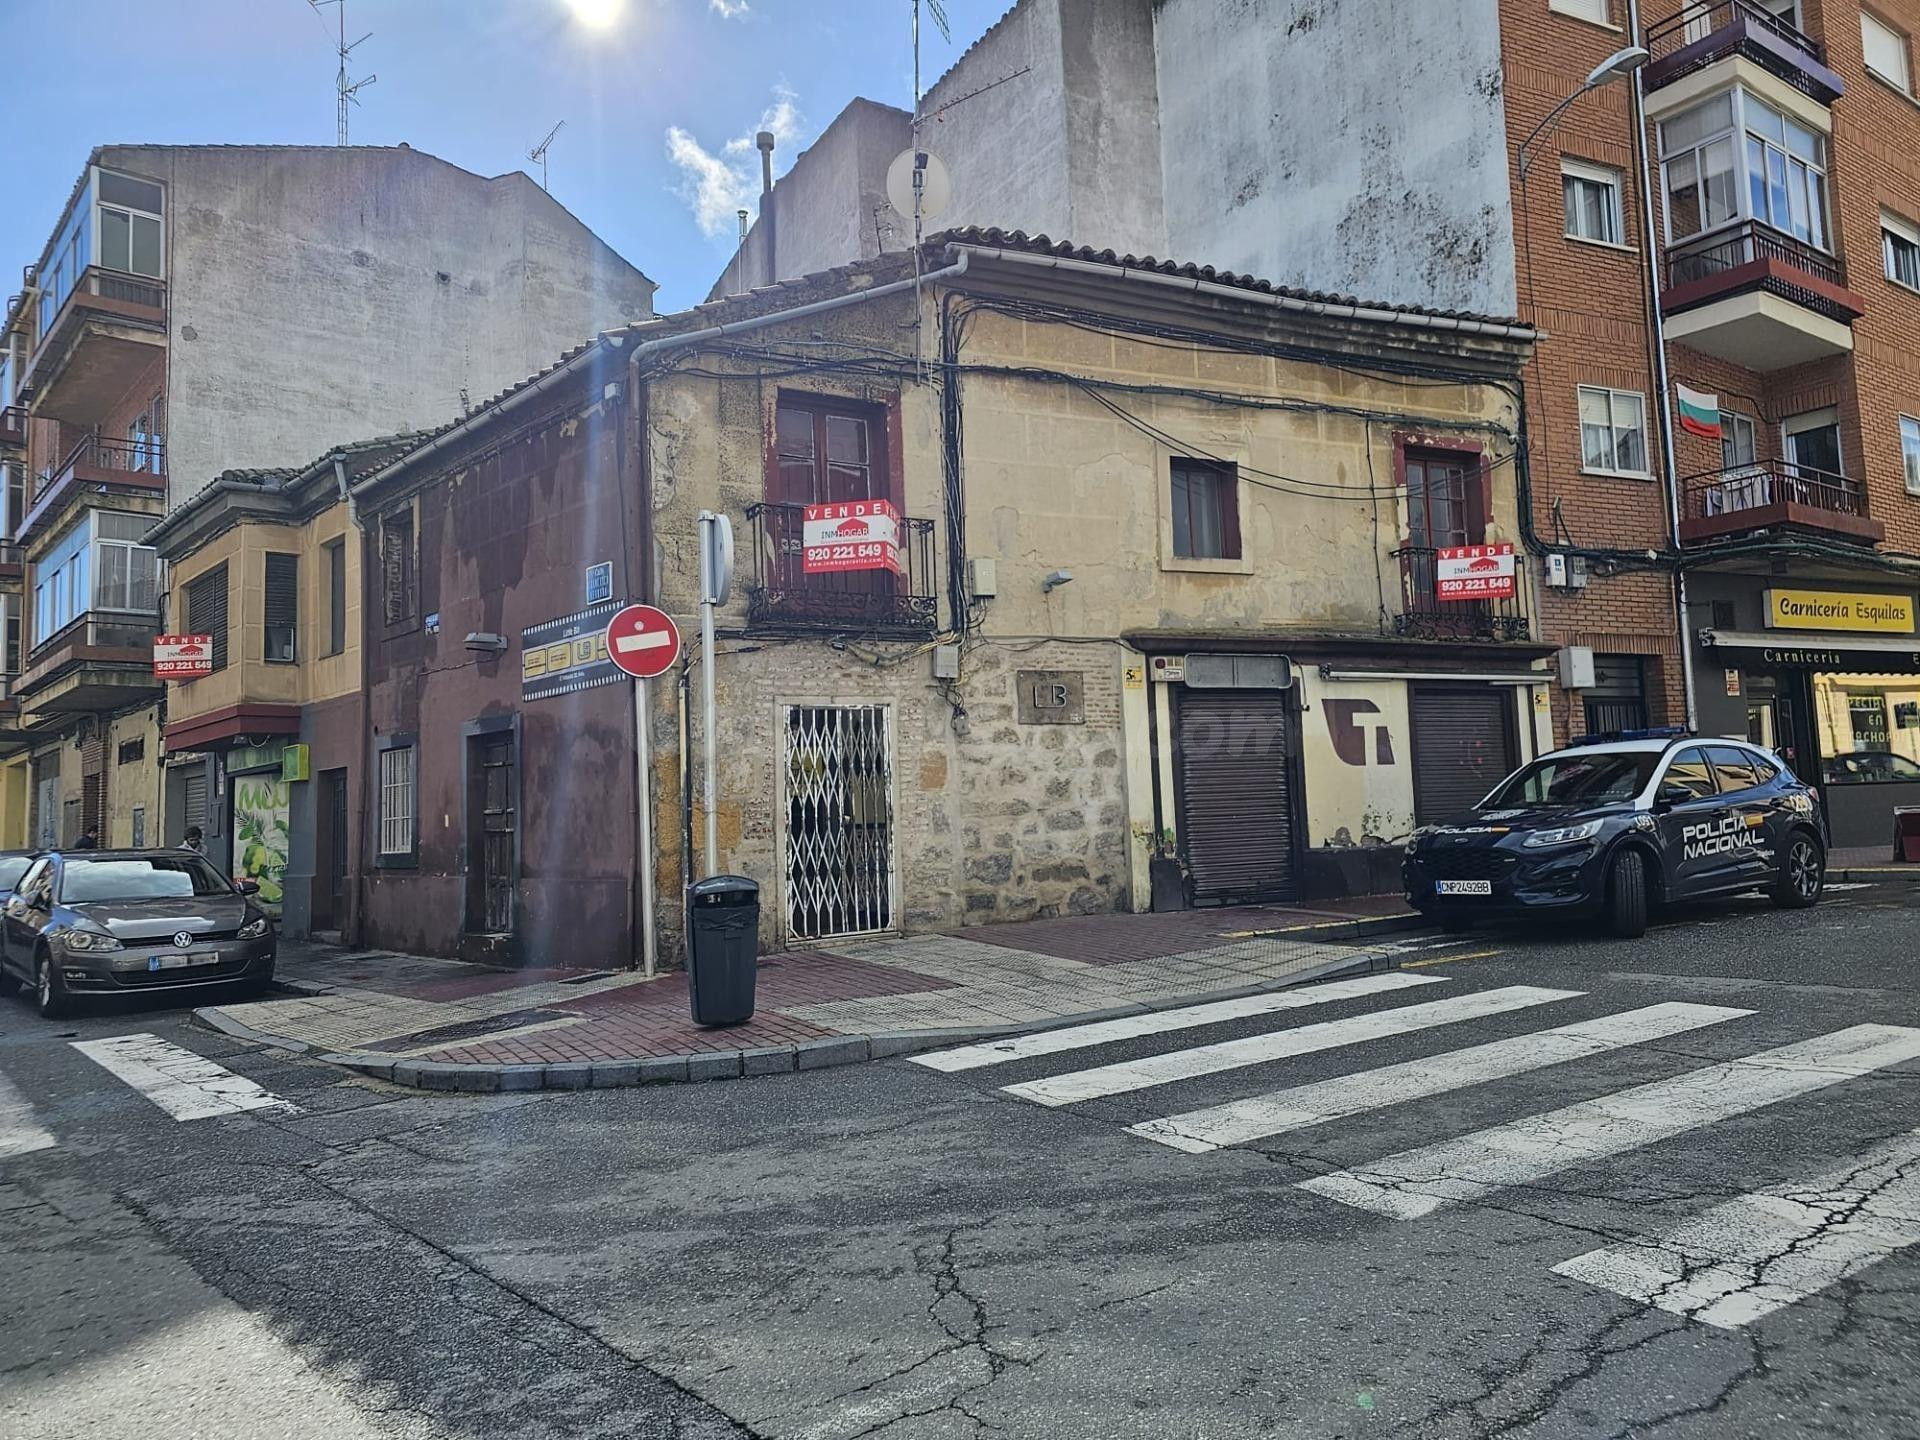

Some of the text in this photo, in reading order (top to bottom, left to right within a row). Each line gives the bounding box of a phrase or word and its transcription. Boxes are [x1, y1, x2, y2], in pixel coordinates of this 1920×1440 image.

[808, 503, 882, 520] VENDE
[808, 548, 831, 561] 920
[832, 546, 856, 559] 221
[857, 543, 882, 556] 549
[1441, 545, 1511, 560] VENDE
[1442, 577, 1511, 592] 920 221 549
[1779, 597, 1906, 624] Carnicería Esquilas
[156, 636, 213, 645] VENDE
[157, 660, 212, 671] 920 221 549
[1032, 683, 1068, 709] LB
[1683, 829, 1766, 861] NACIONAL
